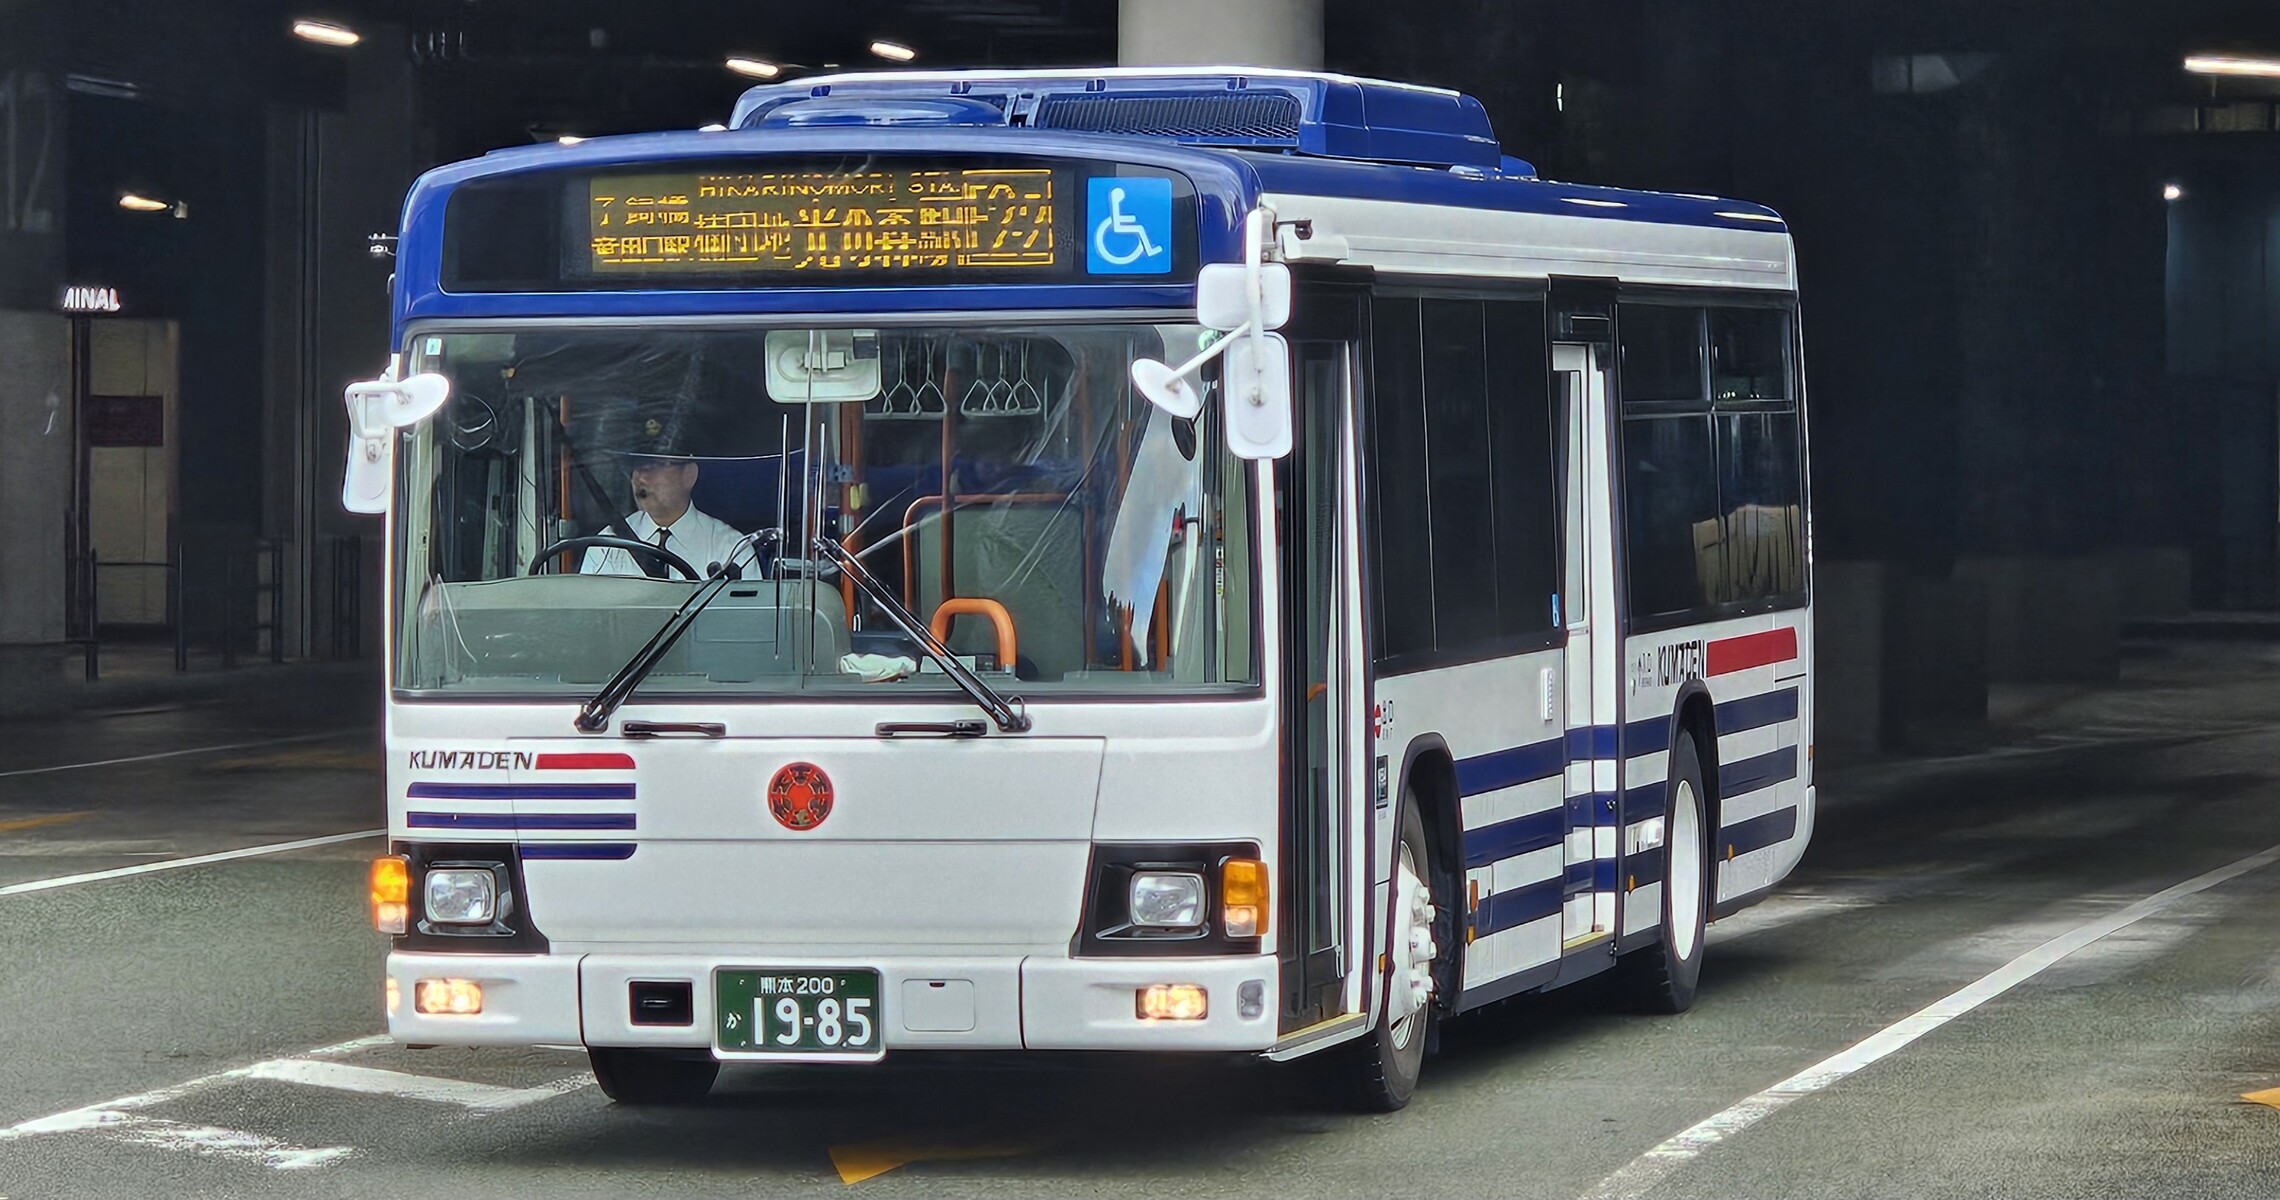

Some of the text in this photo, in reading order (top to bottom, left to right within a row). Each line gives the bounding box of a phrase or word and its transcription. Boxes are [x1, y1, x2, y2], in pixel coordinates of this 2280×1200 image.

[408, 750, 533, 770] KUMADEN
[796, 976, 834, 995] 200
[726, 997, 872, 1046] か 19-85
